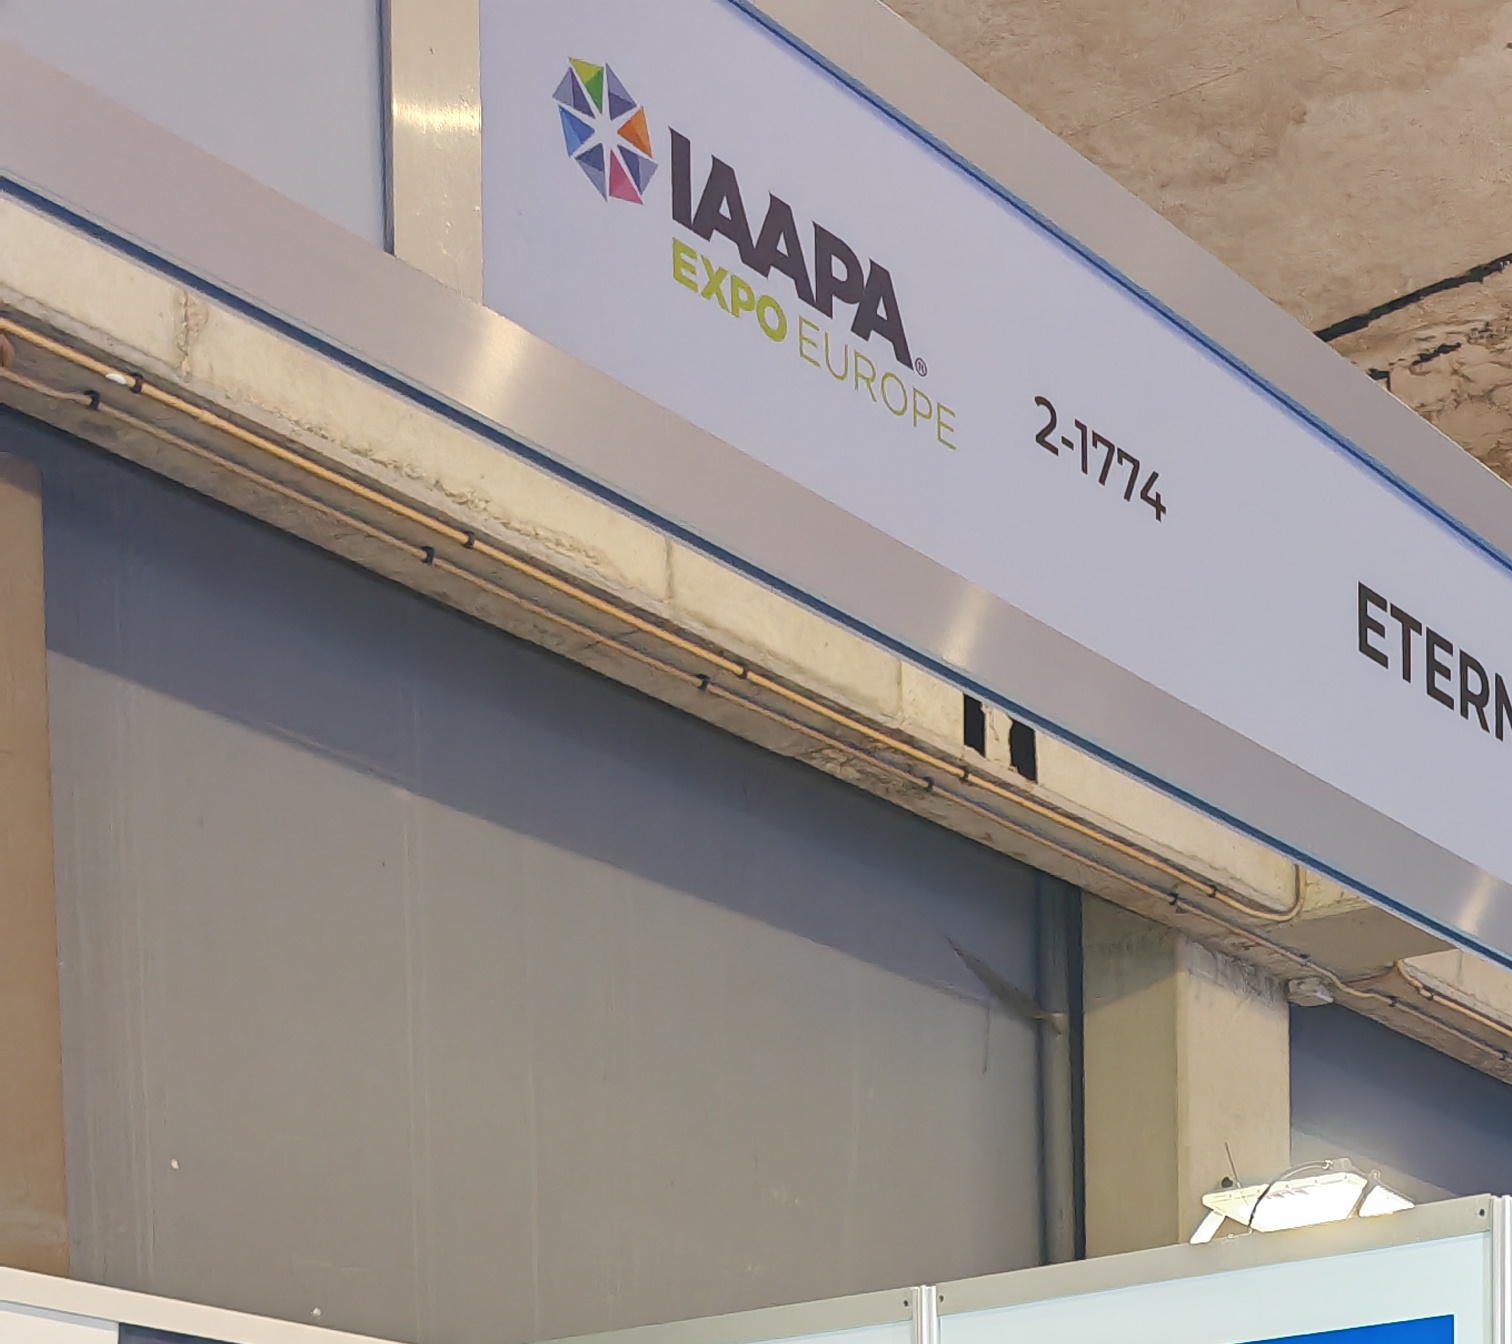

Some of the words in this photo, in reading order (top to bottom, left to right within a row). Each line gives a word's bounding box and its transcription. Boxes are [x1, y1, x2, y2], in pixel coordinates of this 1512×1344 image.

[672, 237, 788, 343] EXPO
[798, 315, 957, 450] EUROPE
[1034, 395, 1167, 522] 2-1774
